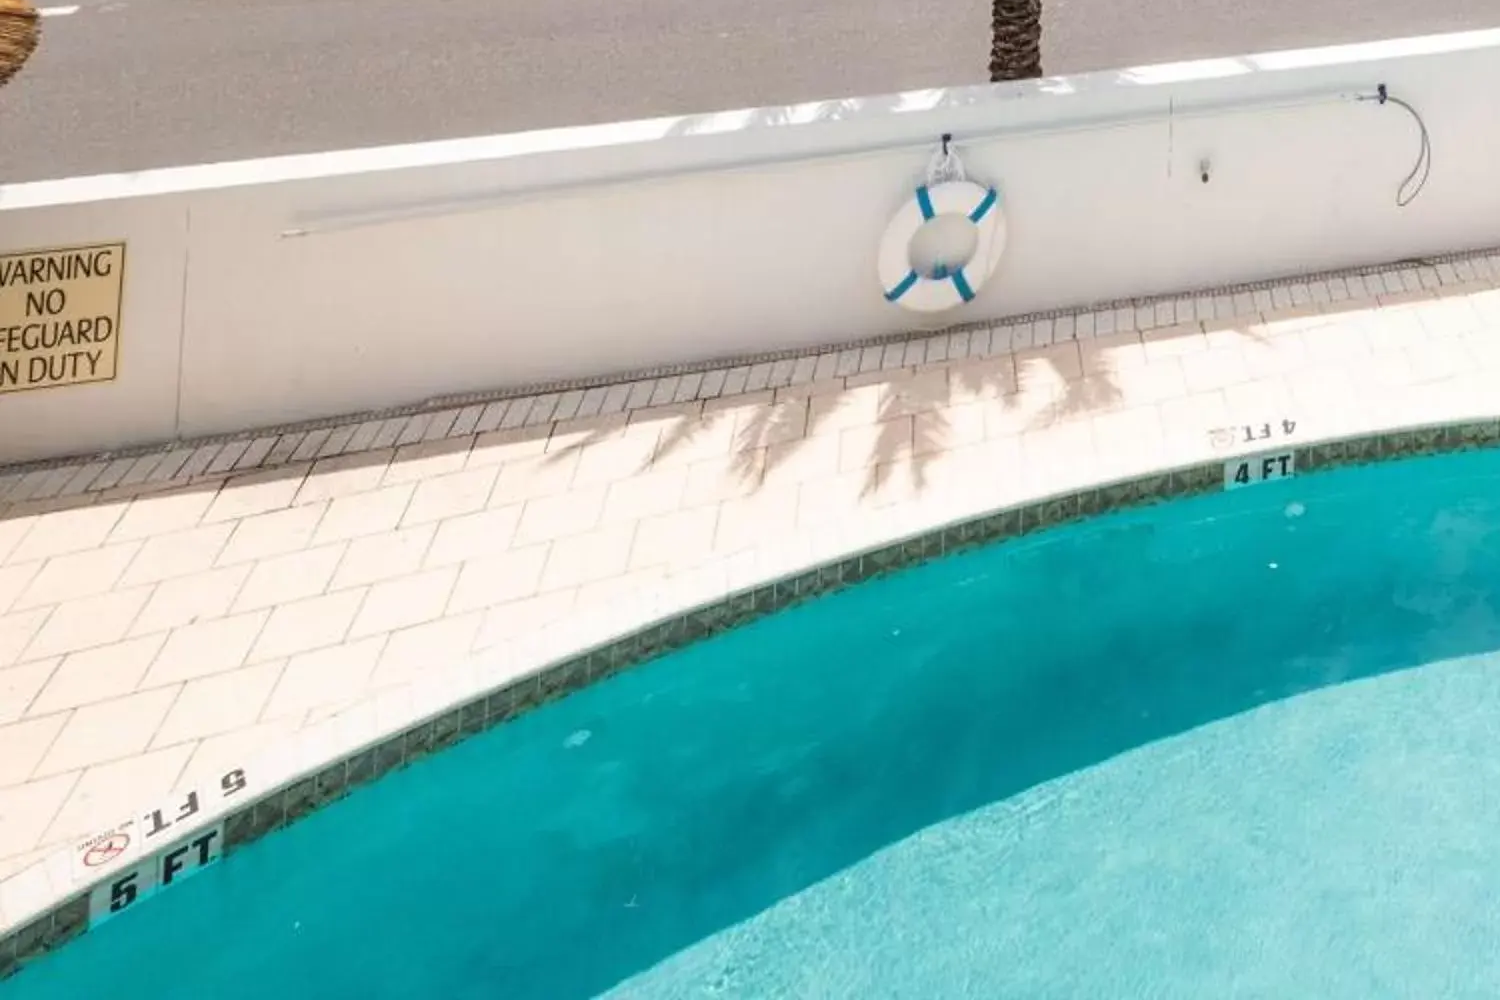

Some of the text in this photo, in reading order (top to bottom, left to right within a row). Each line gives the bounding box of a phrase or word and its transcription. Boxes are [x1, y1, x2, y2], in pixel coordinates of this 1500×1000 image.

[25, 288, 66, 317] NO
[29, 350, 103, 384] DUTY
[1281, 419, 1297, 436] 4
[1234, 463, 1250, 484] 4
[221, 768, 248, 797] 5
[110, 871, 139, 913] 5
